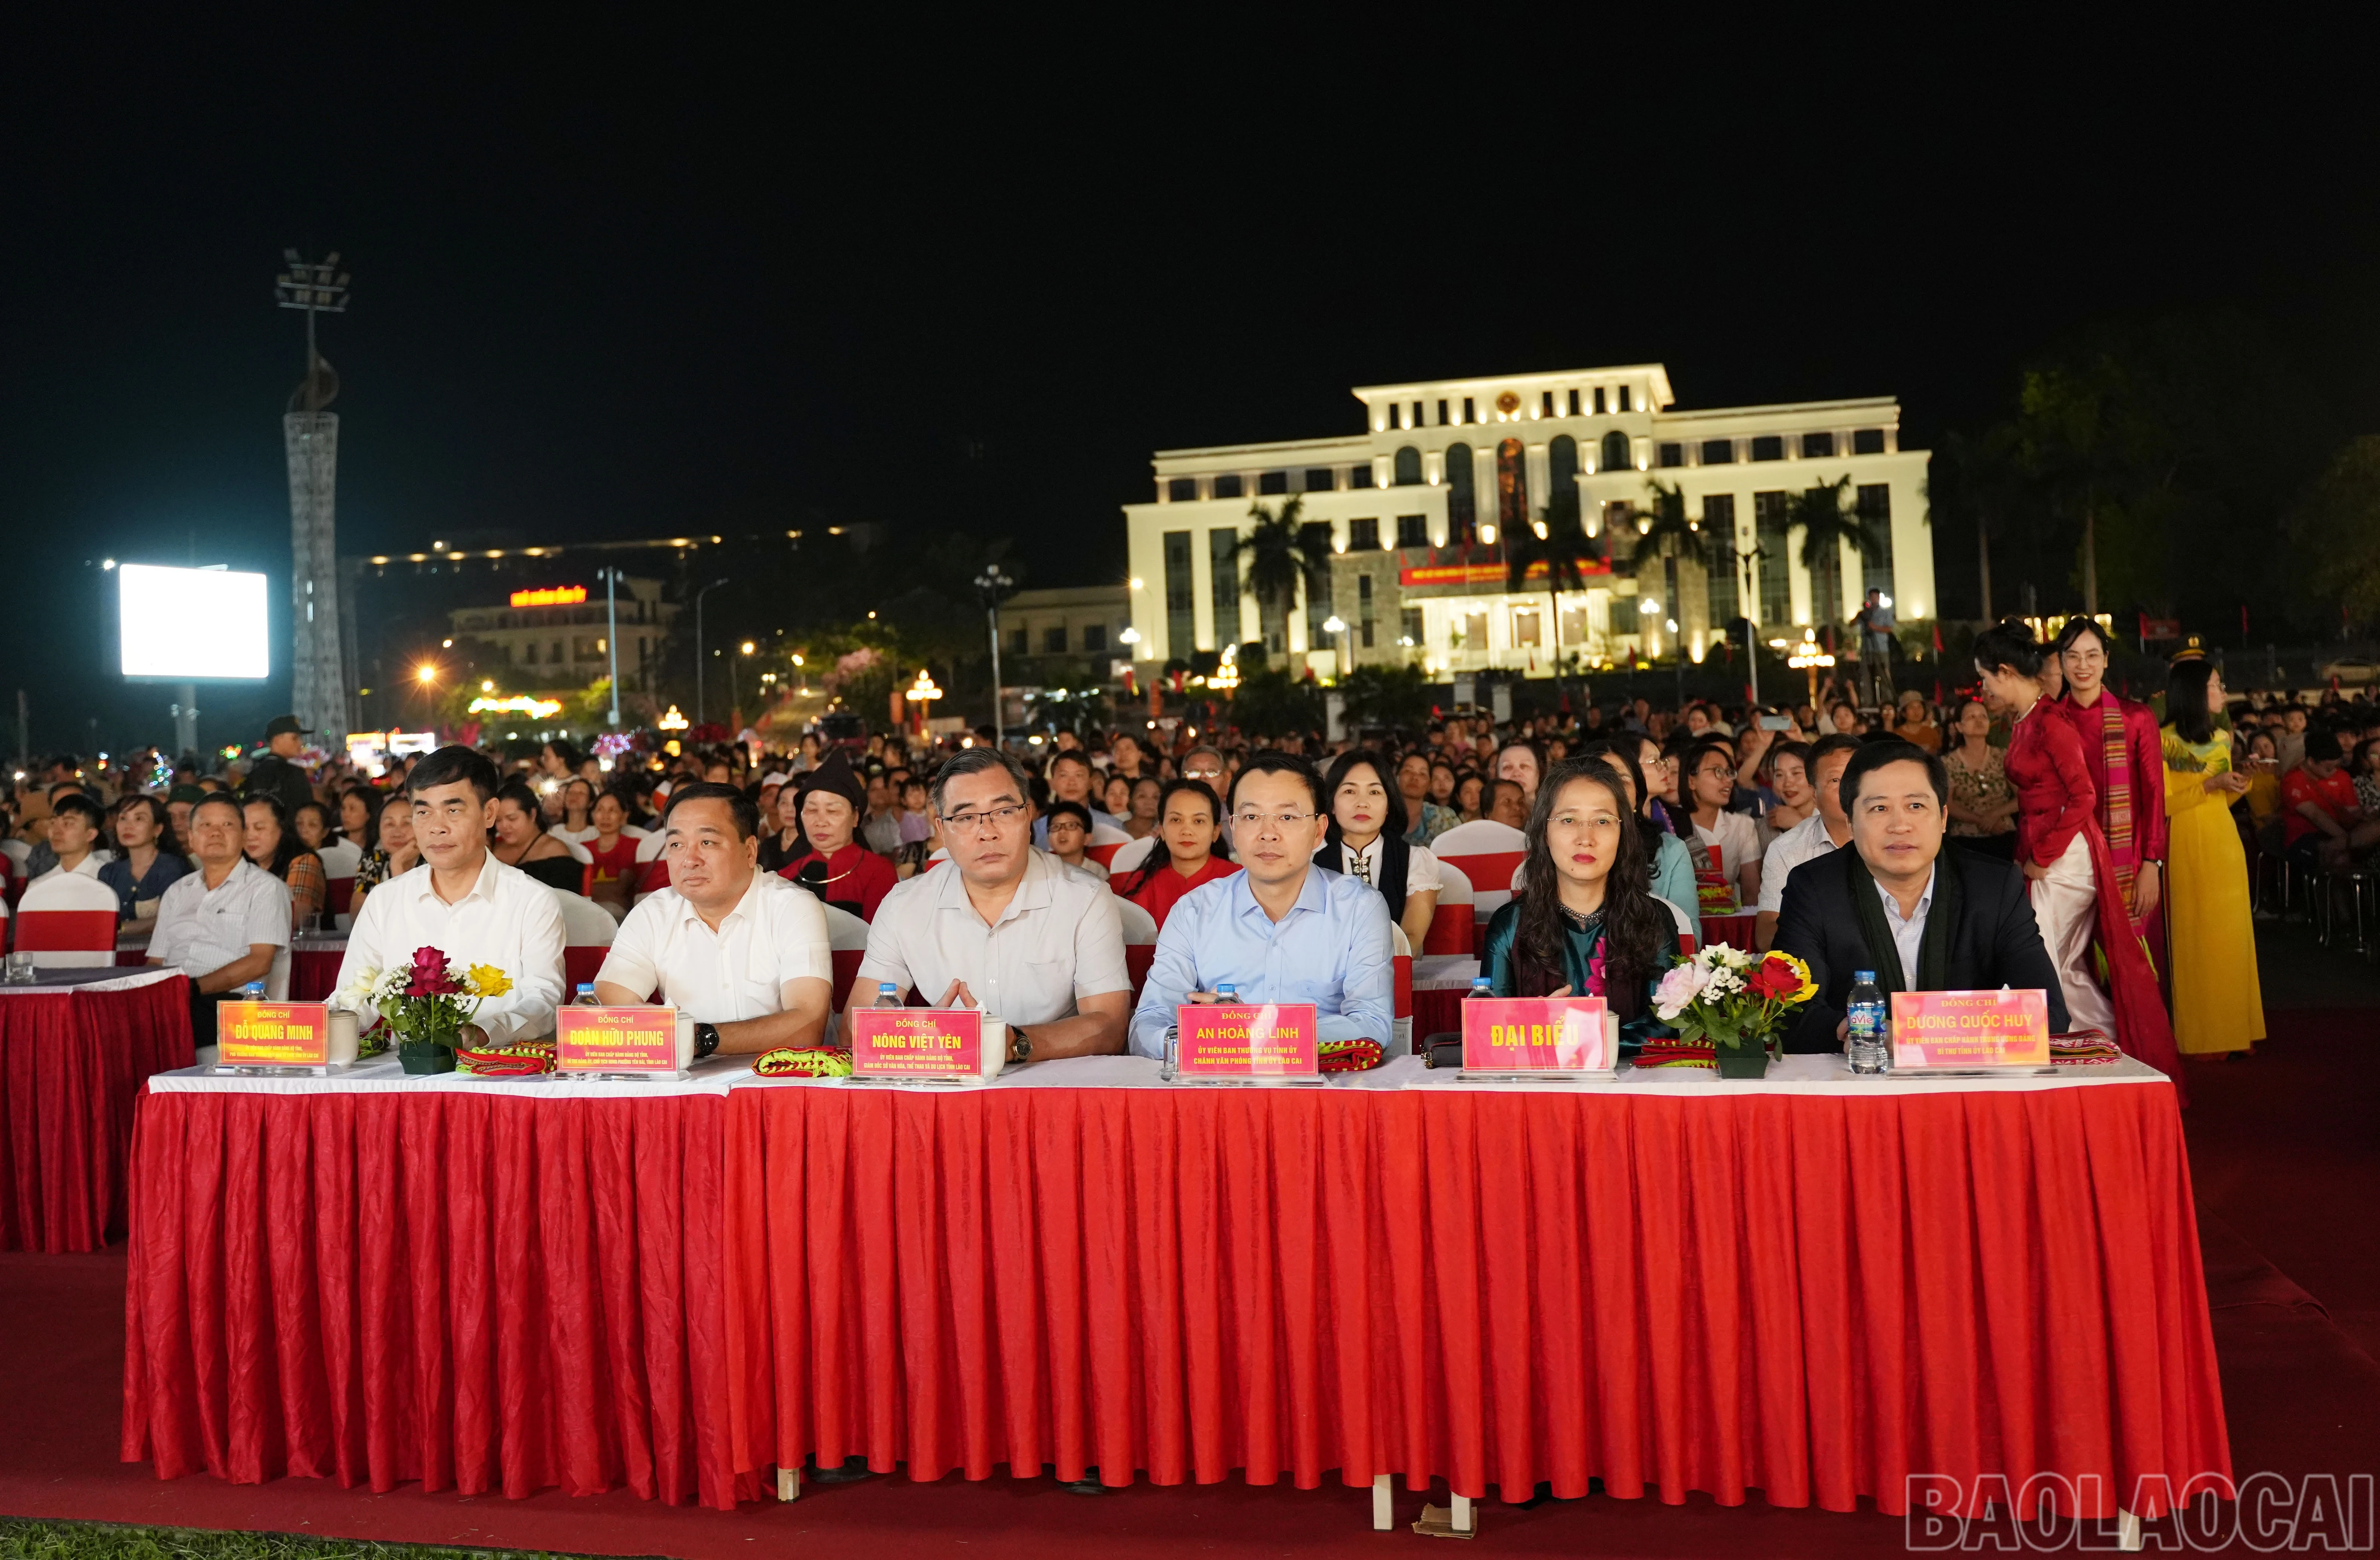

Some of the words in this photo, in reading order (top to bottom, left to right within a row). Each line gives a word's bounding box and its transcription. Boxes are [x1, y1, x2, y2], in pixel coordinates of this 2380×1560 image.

[1941, 997, 1973, 1007] ĐỒNG
[1976, 998, 1996, 1006] CHÍ
[1222, 1010, 1250, 1019] ĐỒNG
[1907, 1015, 1956, 1029] DƯƠNG
[1960, 1010, 2000, 1028] QUỐC
[2004, 1014, 2032, 1027] HUY
[235, 1020, 248, 1039] ĐỖ
[252, 1025, 284, 1041] QUANG
[287, 1025, 313, 1040] MINH
[922, 1019, 936, 1027] CHÍ
[570, 1027, 599, 1045] ĐOÀN
[602, 1028, 624, 1045] HỮU
[627, 1031, 664, 1046] PHUNG
[1196, 1028, 1214, 1039] AN
[1218, 1025, 1265, 1039] HOÀNG
[1269, 1027, 1298, 1039] LINH
[1491, 1025, 1525, 1051] ĐẠI
[1531, 1015, 1578, 1046] BIỂU
[873, 1033, 905, 1048] NÔNG
[909, 1033, 934, 1051] VIỆT
[937, 1034, 961, 1049] YÊN
[1198, 1045, 1206, 1054] ỦY
[1273, 1045, 1287, 1054] TỈNH
[1289, 1045, 1297, 1054] ỦY
